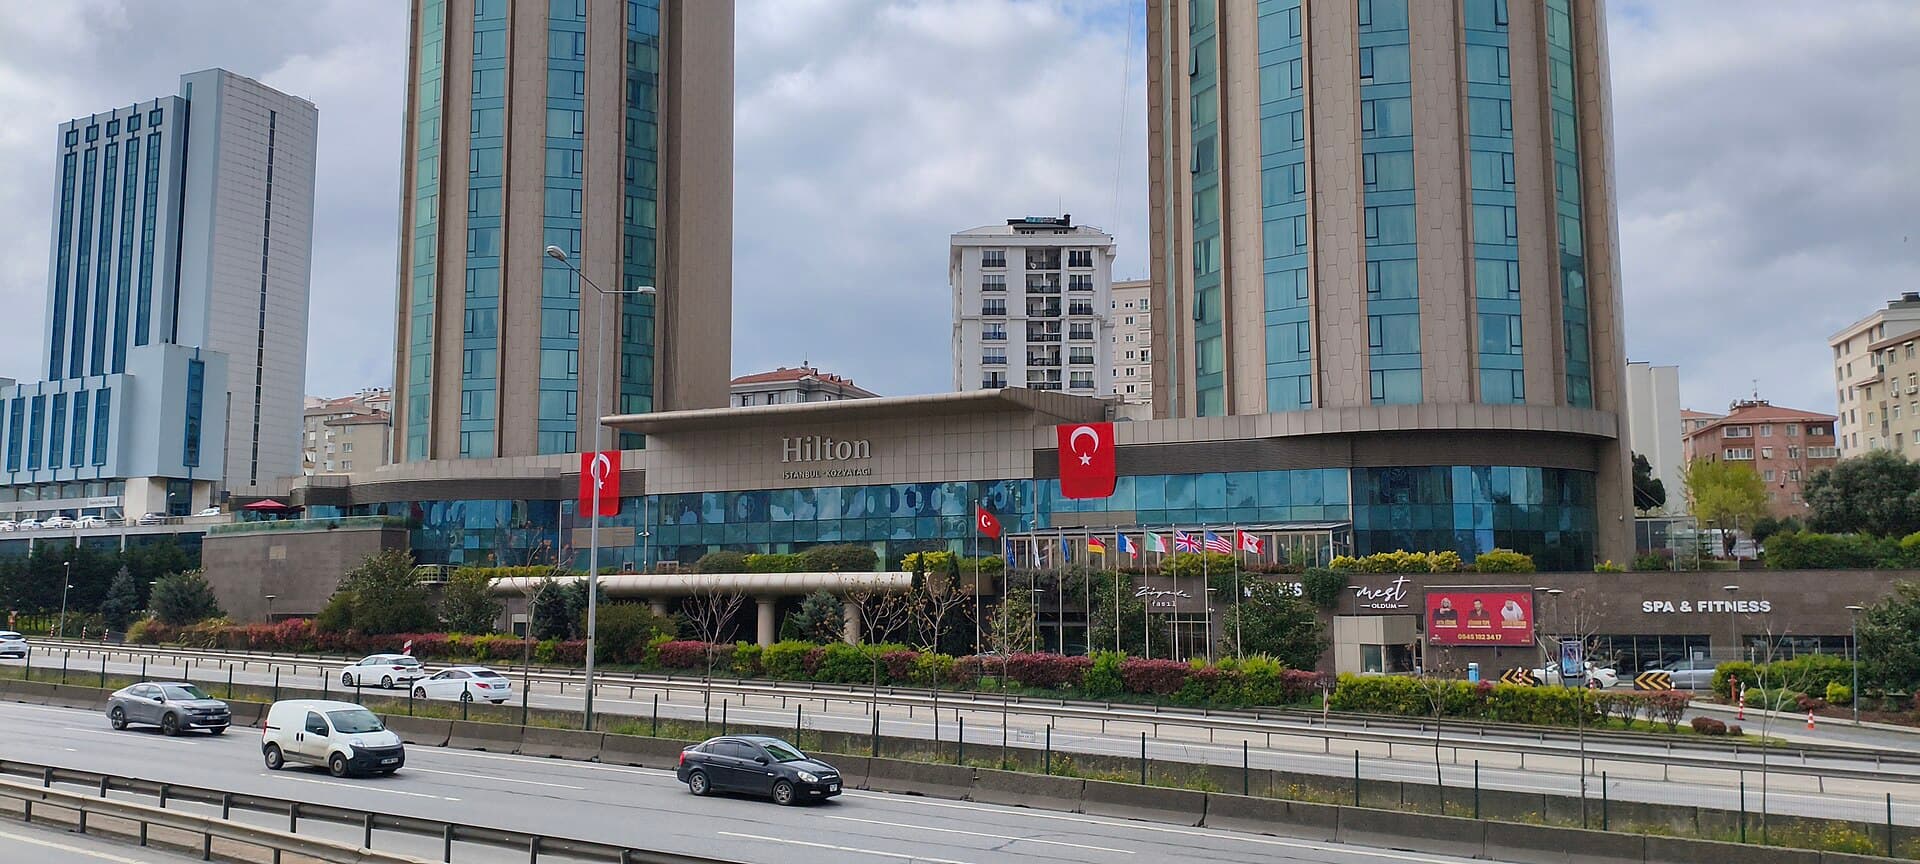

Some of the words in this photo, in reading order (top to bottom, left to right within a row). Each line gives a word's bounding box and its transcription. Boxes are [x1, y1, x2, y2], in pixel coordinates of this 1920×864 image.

[781, 435, 871, 463] Hilton
[1642, 600, 1675, 613] SPA
[1679, 600, 1693, 613] &
[1697, 600, 1772, 613] FITNESS
